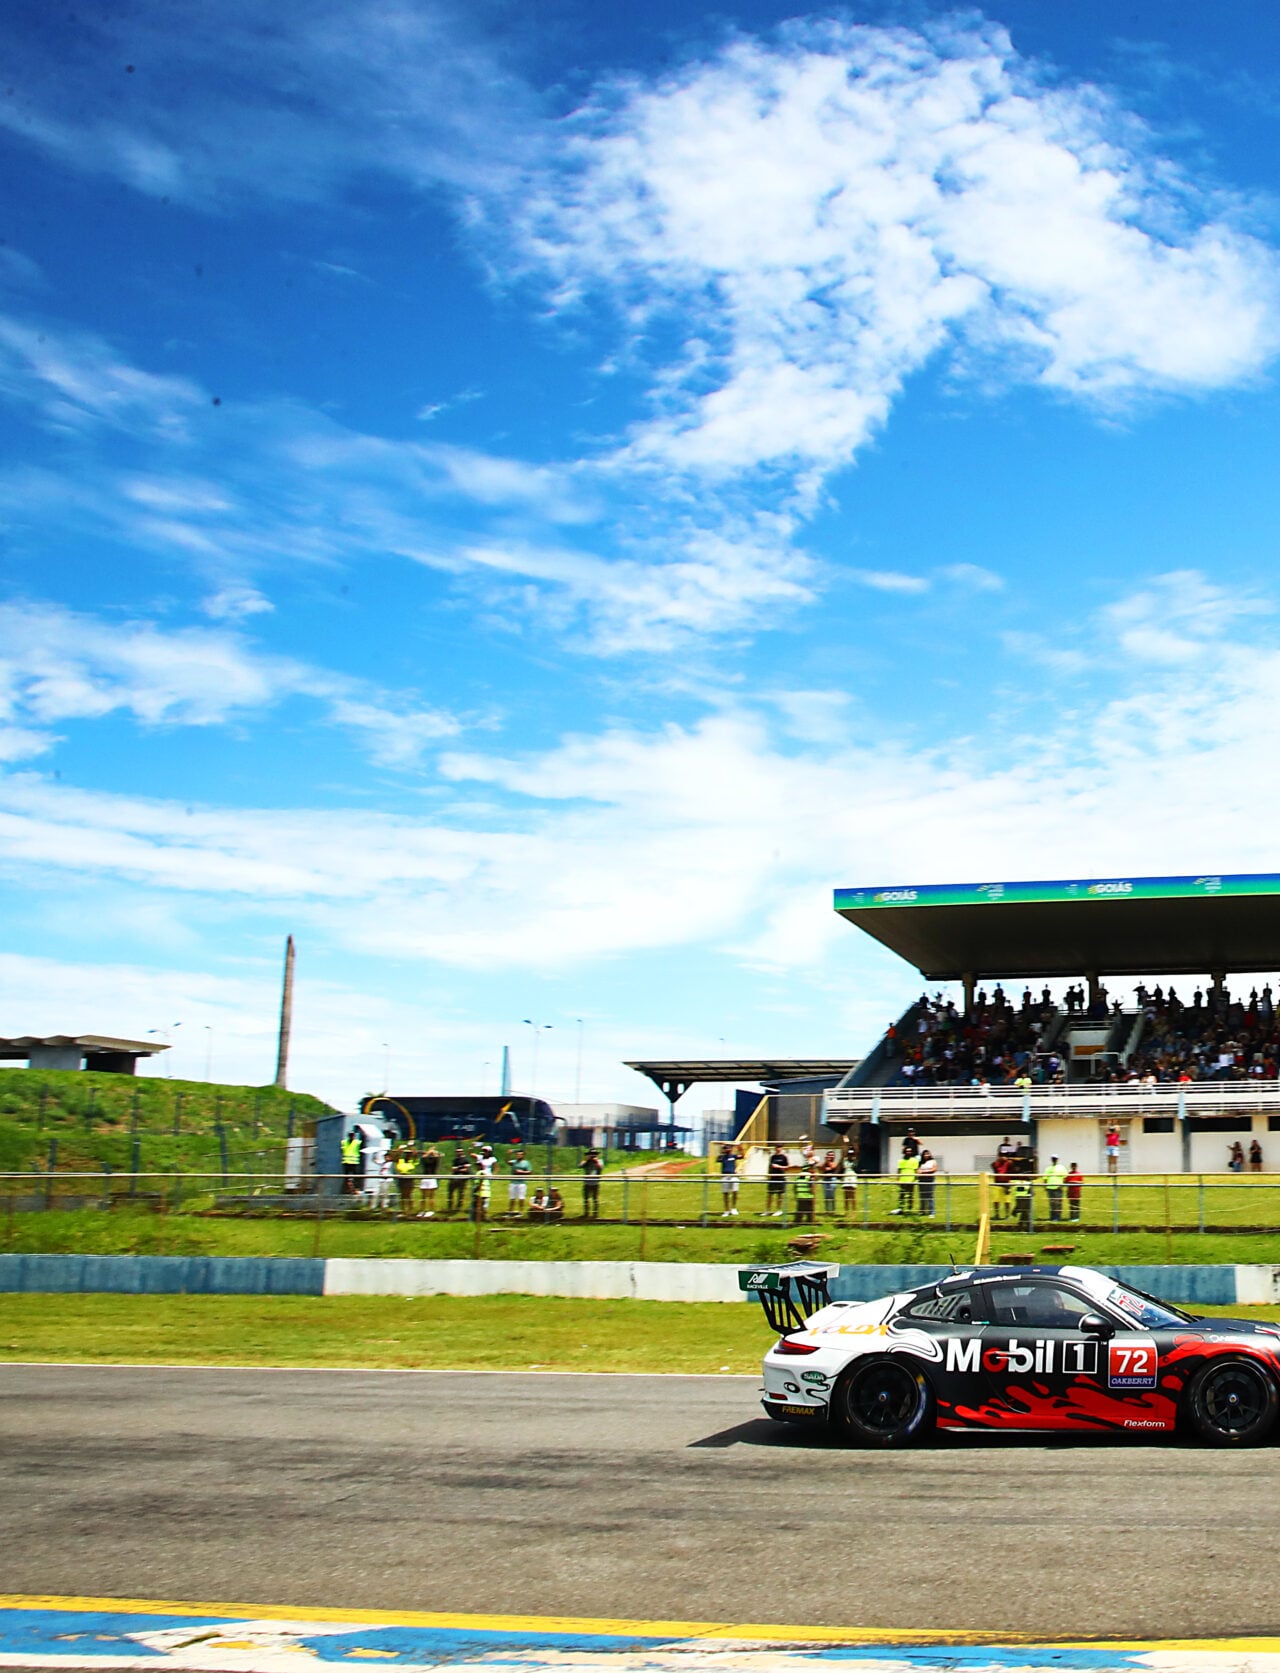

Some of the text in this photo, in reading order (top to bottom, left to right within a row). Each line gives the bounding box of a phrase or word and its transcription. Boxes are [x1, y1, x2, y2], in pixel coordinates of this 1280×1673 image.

[946, 1338, 1055, 1373] Mobil
[1116, 1349, 1148, 1374] 72
[782, 1406, 816, 1416] FREMAX
[1123, 1419, 1166, 1428] Flexform
